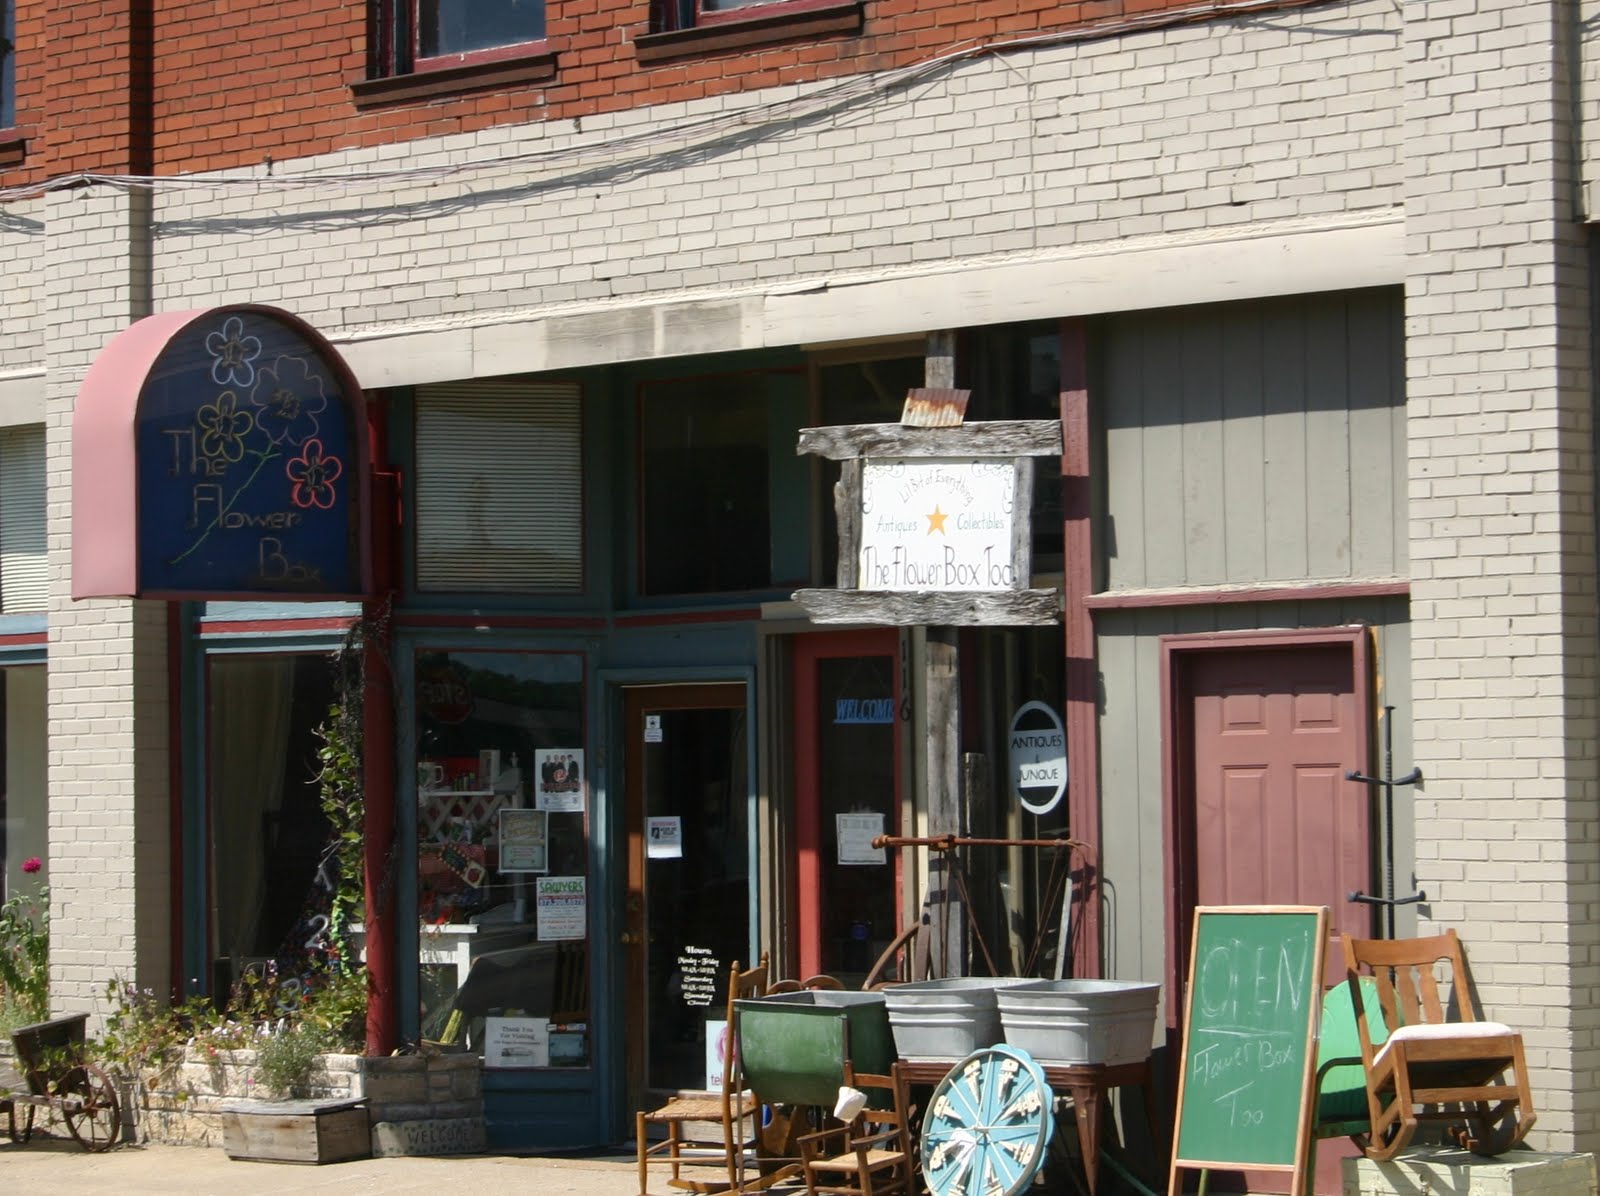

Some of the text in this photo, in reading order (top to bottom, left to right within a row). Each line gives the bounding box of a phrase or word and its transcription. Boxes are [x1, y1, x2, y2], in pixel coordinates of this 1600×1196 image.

[161, 426, 229, 477] The
[186, 483, 302, 529] Flower
[909, 473, 924, 492] Bit
[925, 469, 933, 486] of
[935, 468, 975, 508] Everything
[876, 512, 1005, 538] Antiques Collectibles
[258, 537, 322, 582] Box
[863, 545, 890, 587] The
[891, 545, 942, 587] Flower
[943, 544, 982, 588] Box
[1011, 733, 1062, 749] ANTIQUES
[1017, 766, 1059, 785] JUNQUE
[539, 881, 584, 893] SAWYERS
[683, 975, 713, 984] Saturday
[1193, 1040, 1296, 1086] Flower Box
[1213, 1081, 1264, 1127] Too
[408, 1128, 469, 1145] WELCOME
